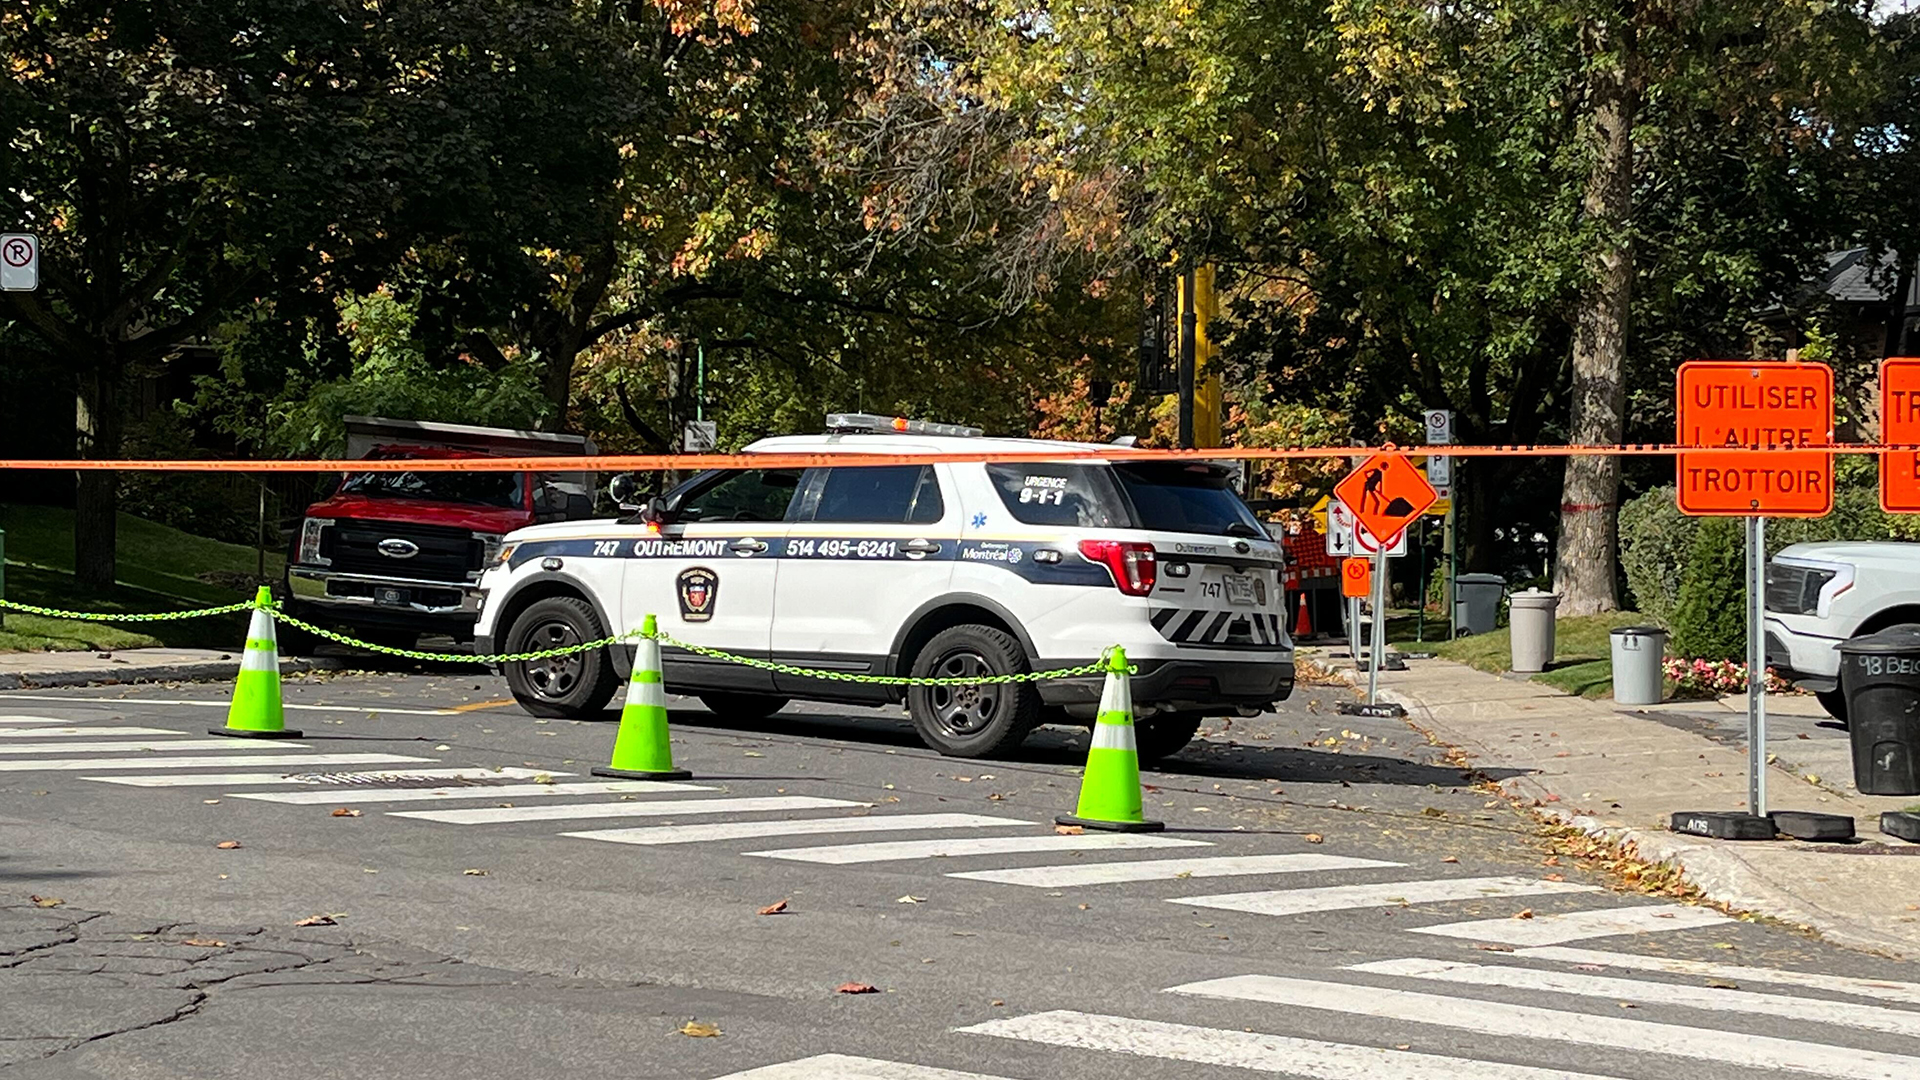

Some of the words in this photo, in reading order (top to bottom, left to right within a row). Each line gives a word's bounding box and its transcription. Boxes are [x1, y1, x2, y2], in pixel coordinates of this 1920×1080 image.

[1694, 384, 1817, 410] UTILISER
[1024, 475, 1068, 489] URGENCE
[1688, 468, 1822, 494] TROTTOIR
[1019, 487, 1064, 506] 9-1-1
[593, 540, 620, 556] 747
[633, 540, 728, 557] OUTREMONT
[786, 539, 815, 556] 514
[817, 540, 897, 558] 495-6241
[962, 548, 1008, 561] Montréal
[1175, 542, 1218, 554] Outremont
[1199, 582, 1221, 598] 747
[1858, 655, 1883, 676] 98
[1687, 818, 1709, 834] ADS
